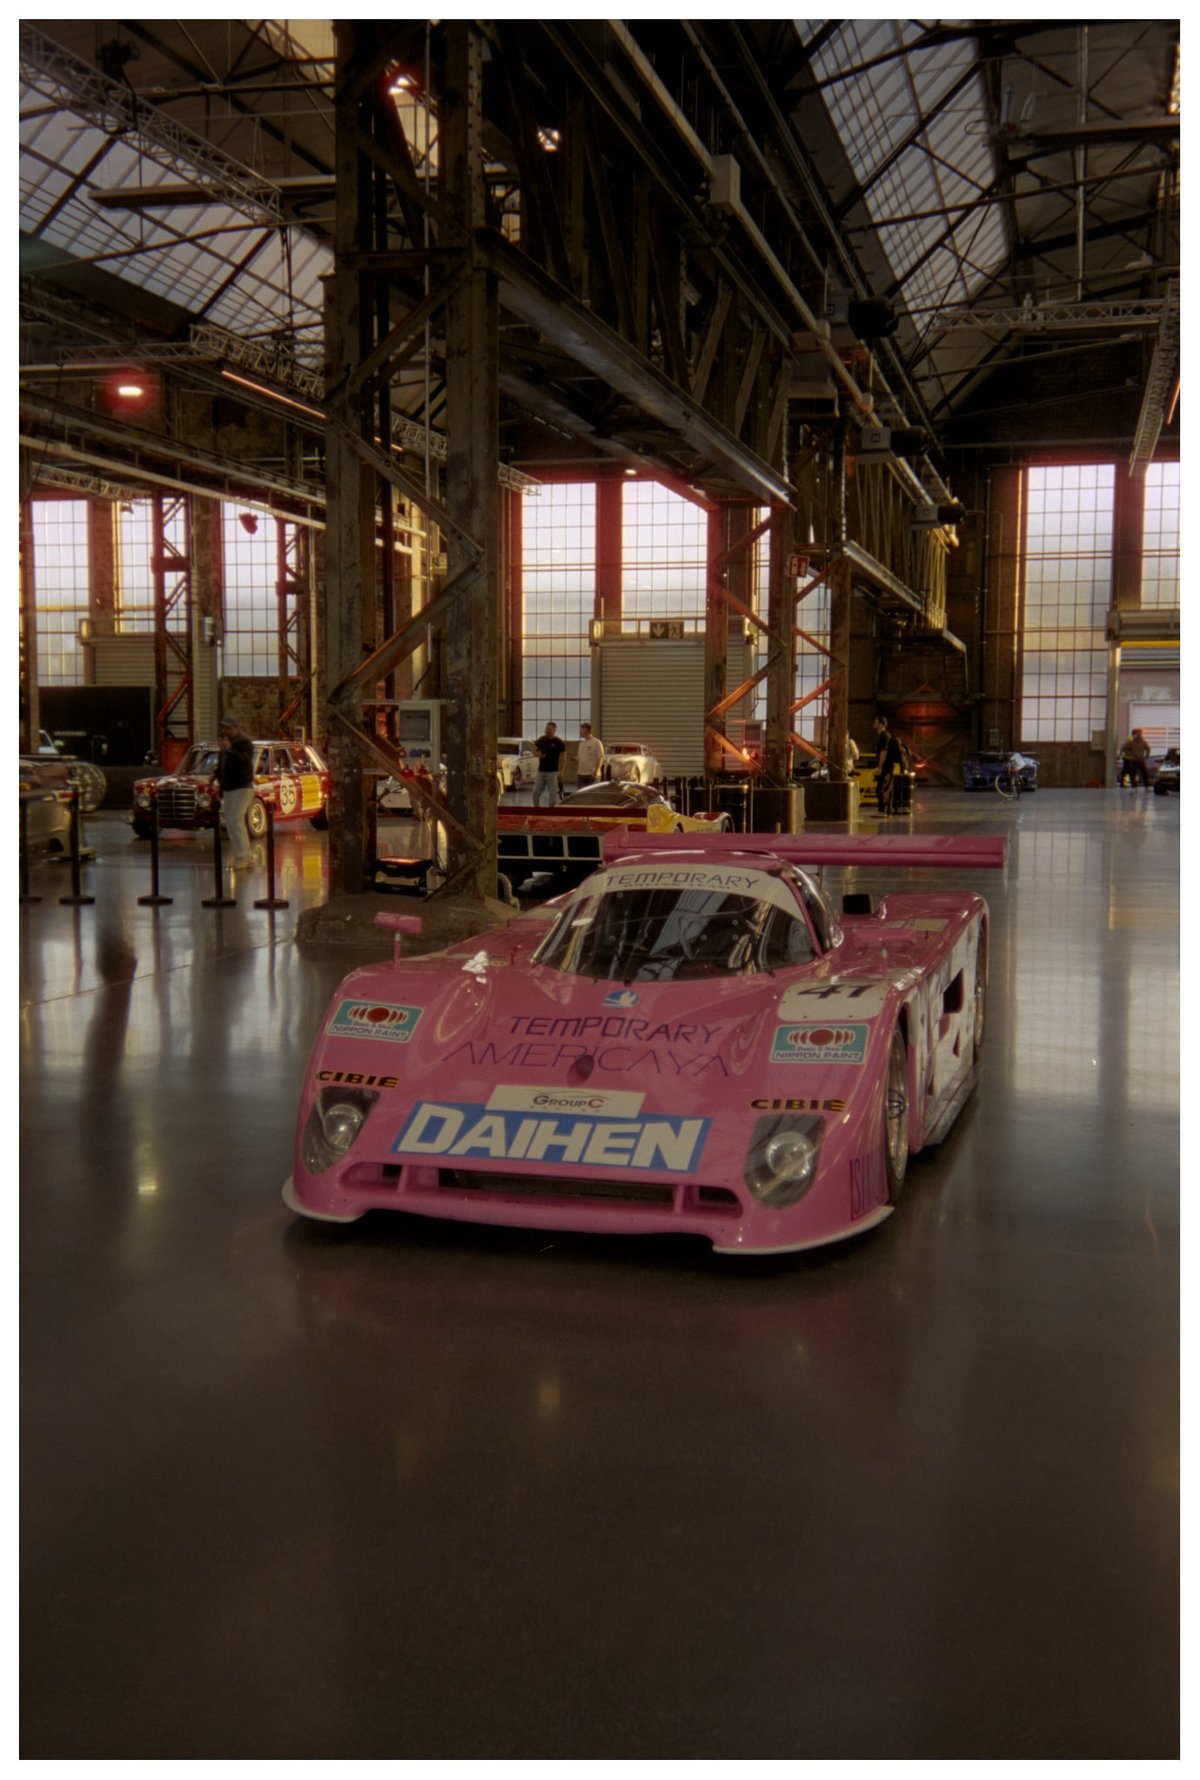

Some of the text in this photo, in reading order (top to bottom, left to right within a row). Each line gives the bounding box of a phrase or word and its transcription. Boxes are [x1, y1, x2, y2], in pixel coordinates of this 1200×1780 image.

[282, 784, 295, 806] 35
[607, 872, 760, 889] TEMPORARY
[333, 1025, 406, 1038] NIPPON PAINT
[510, 1016, 722, 1044] TEMPORARY
[316, 1070, 399, 1088] CIBIE
[750, 1099, 845, 1113] CIBIE
[397, 1103, 704, 1171] DAIHEN
